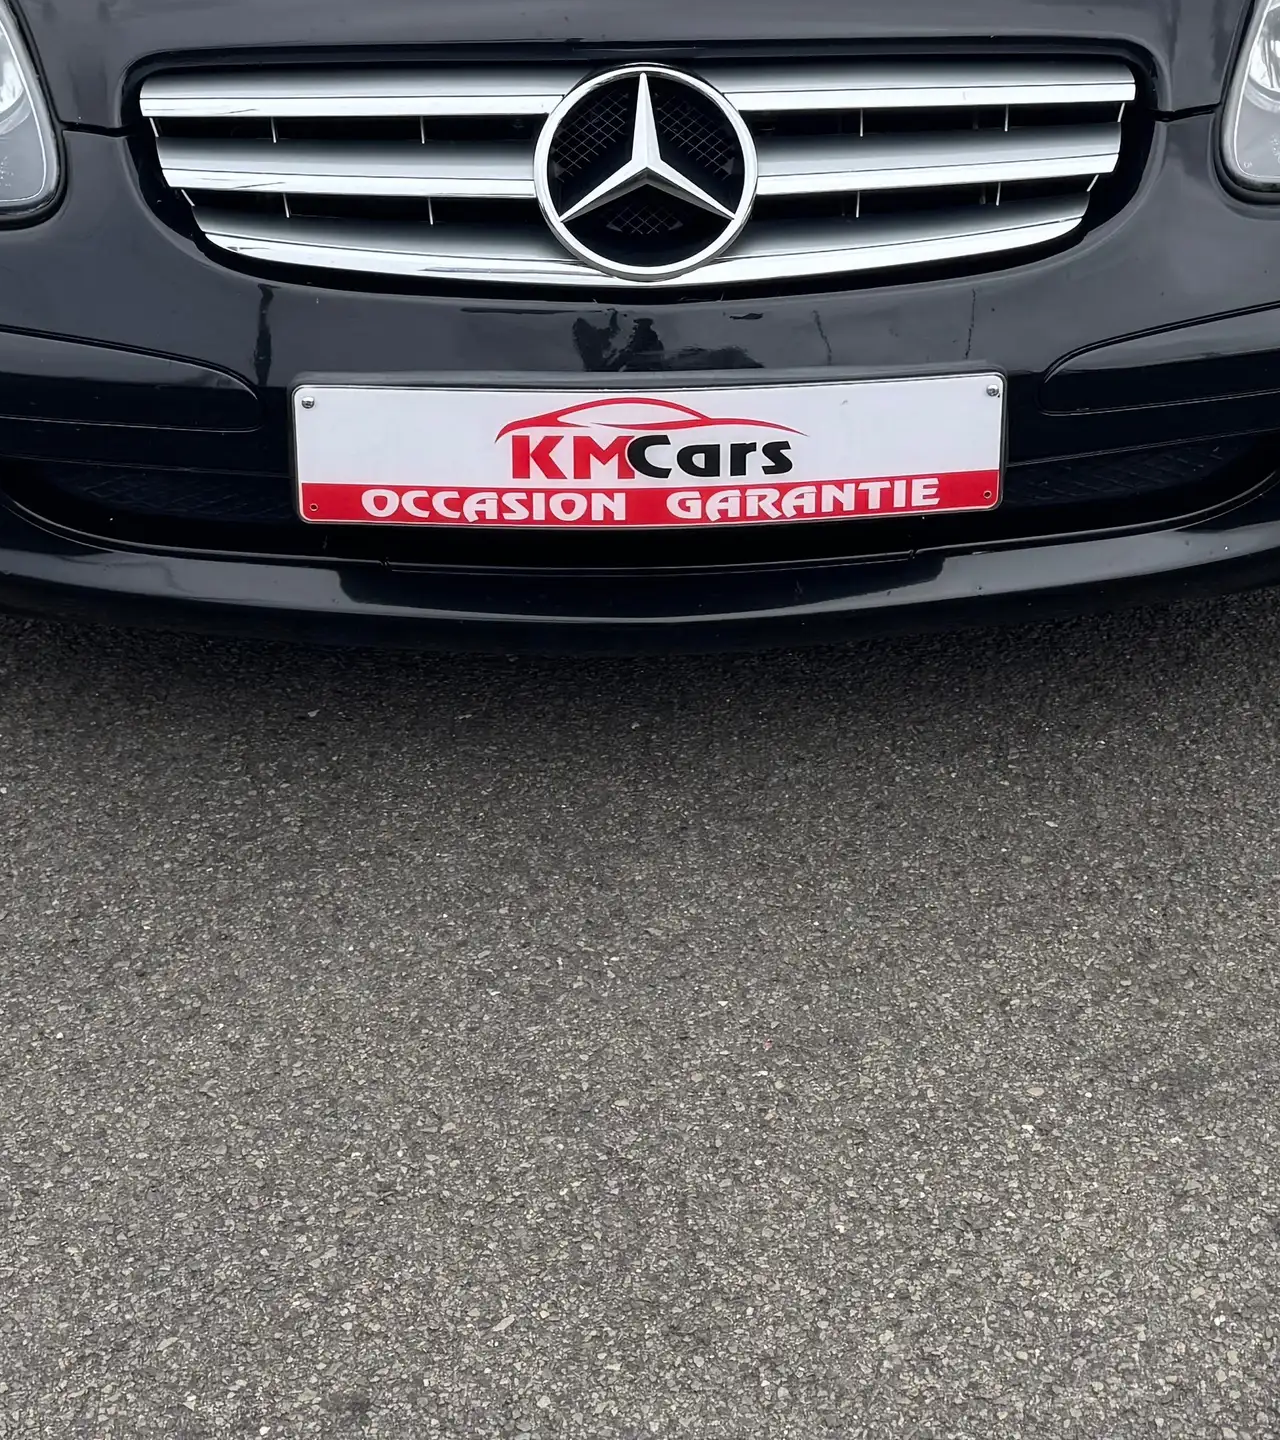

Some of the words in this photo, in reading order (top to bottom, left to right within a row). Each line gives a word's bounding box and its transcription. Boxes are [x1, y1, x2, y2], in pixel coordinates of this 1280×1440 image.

[510, 434, 794, 480] KMCars
[361, 488, 625, 521] OCCASION
[666, 477, 941, 520] GARANTIE
